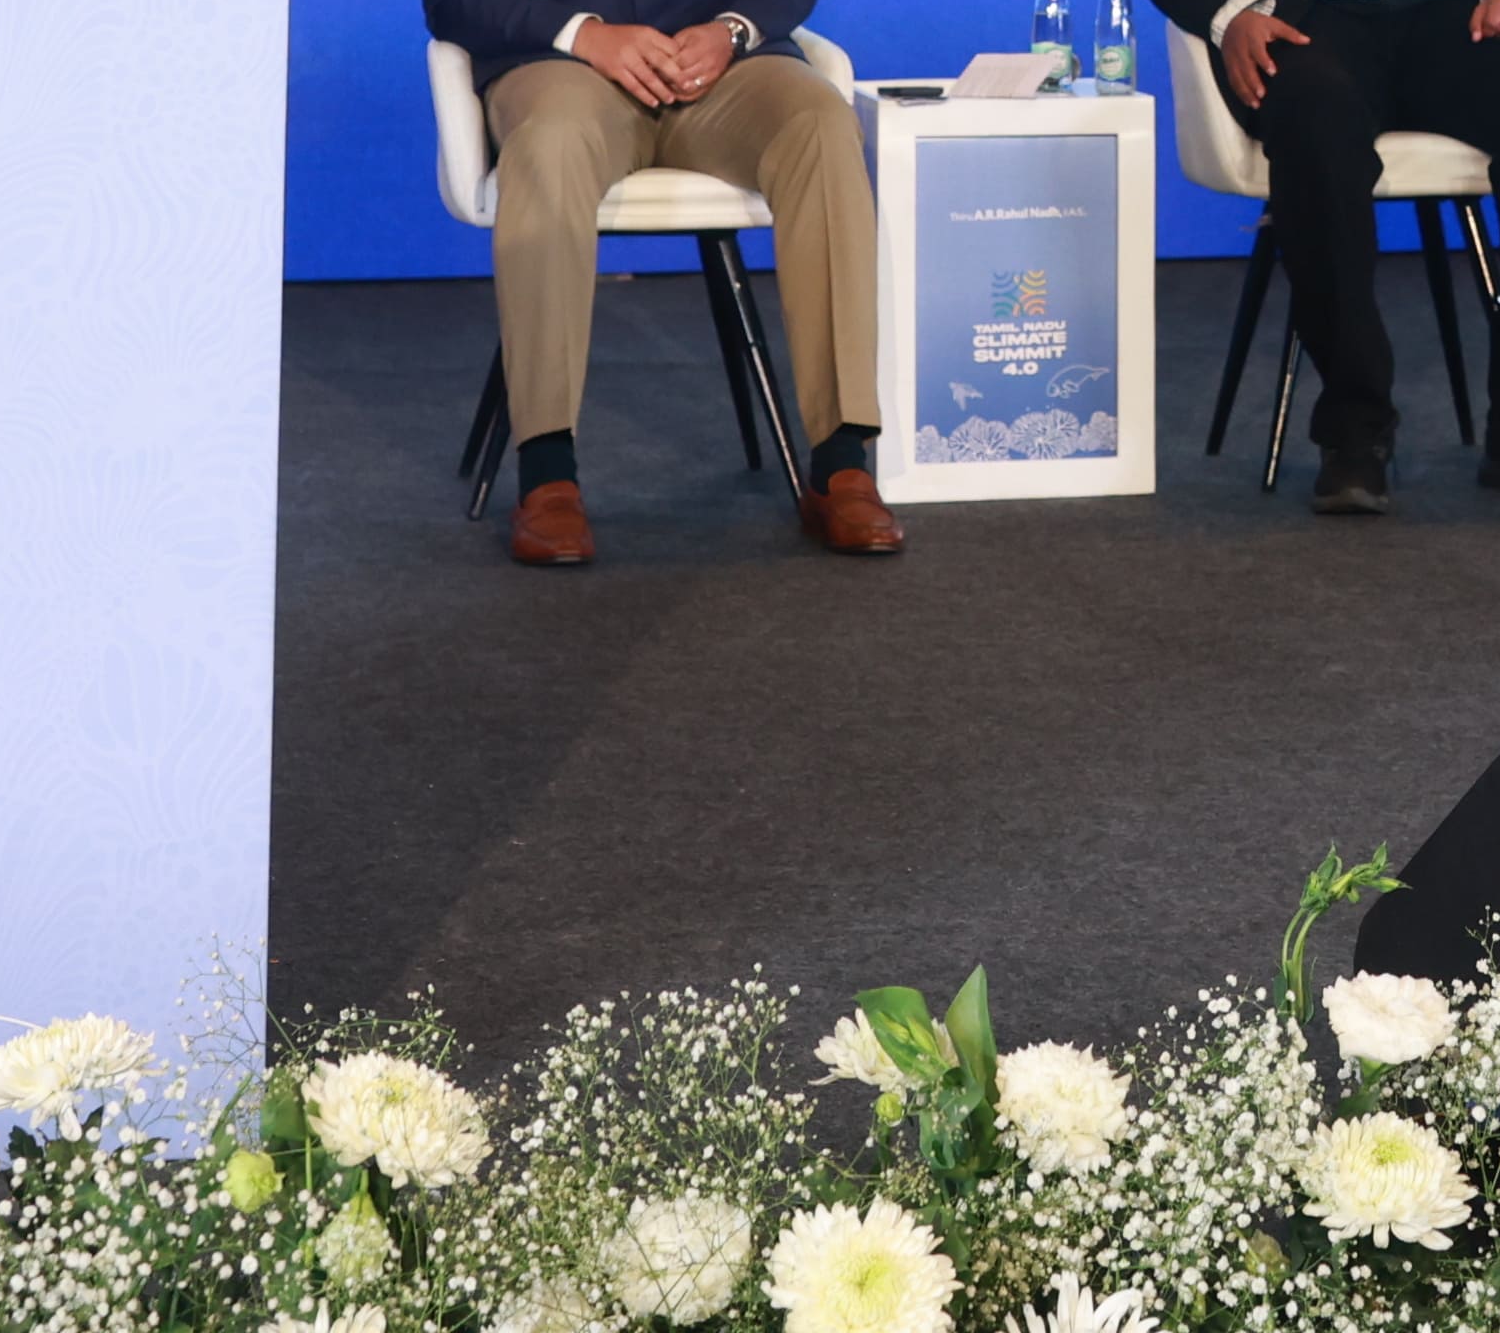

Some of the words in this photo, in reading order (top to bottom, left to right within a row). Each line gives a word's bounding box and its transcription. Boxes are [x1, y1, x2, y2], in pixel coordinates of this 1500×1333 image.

[973, 323, 1020, 335] TAMIL
[1023, 320, 1067, 332] NADU
[973, 331, 1068, 349] CLIMATE
[973, 345, 1068, 364] SUMMIT
[1002, 361, 1040, 376] 4.0
